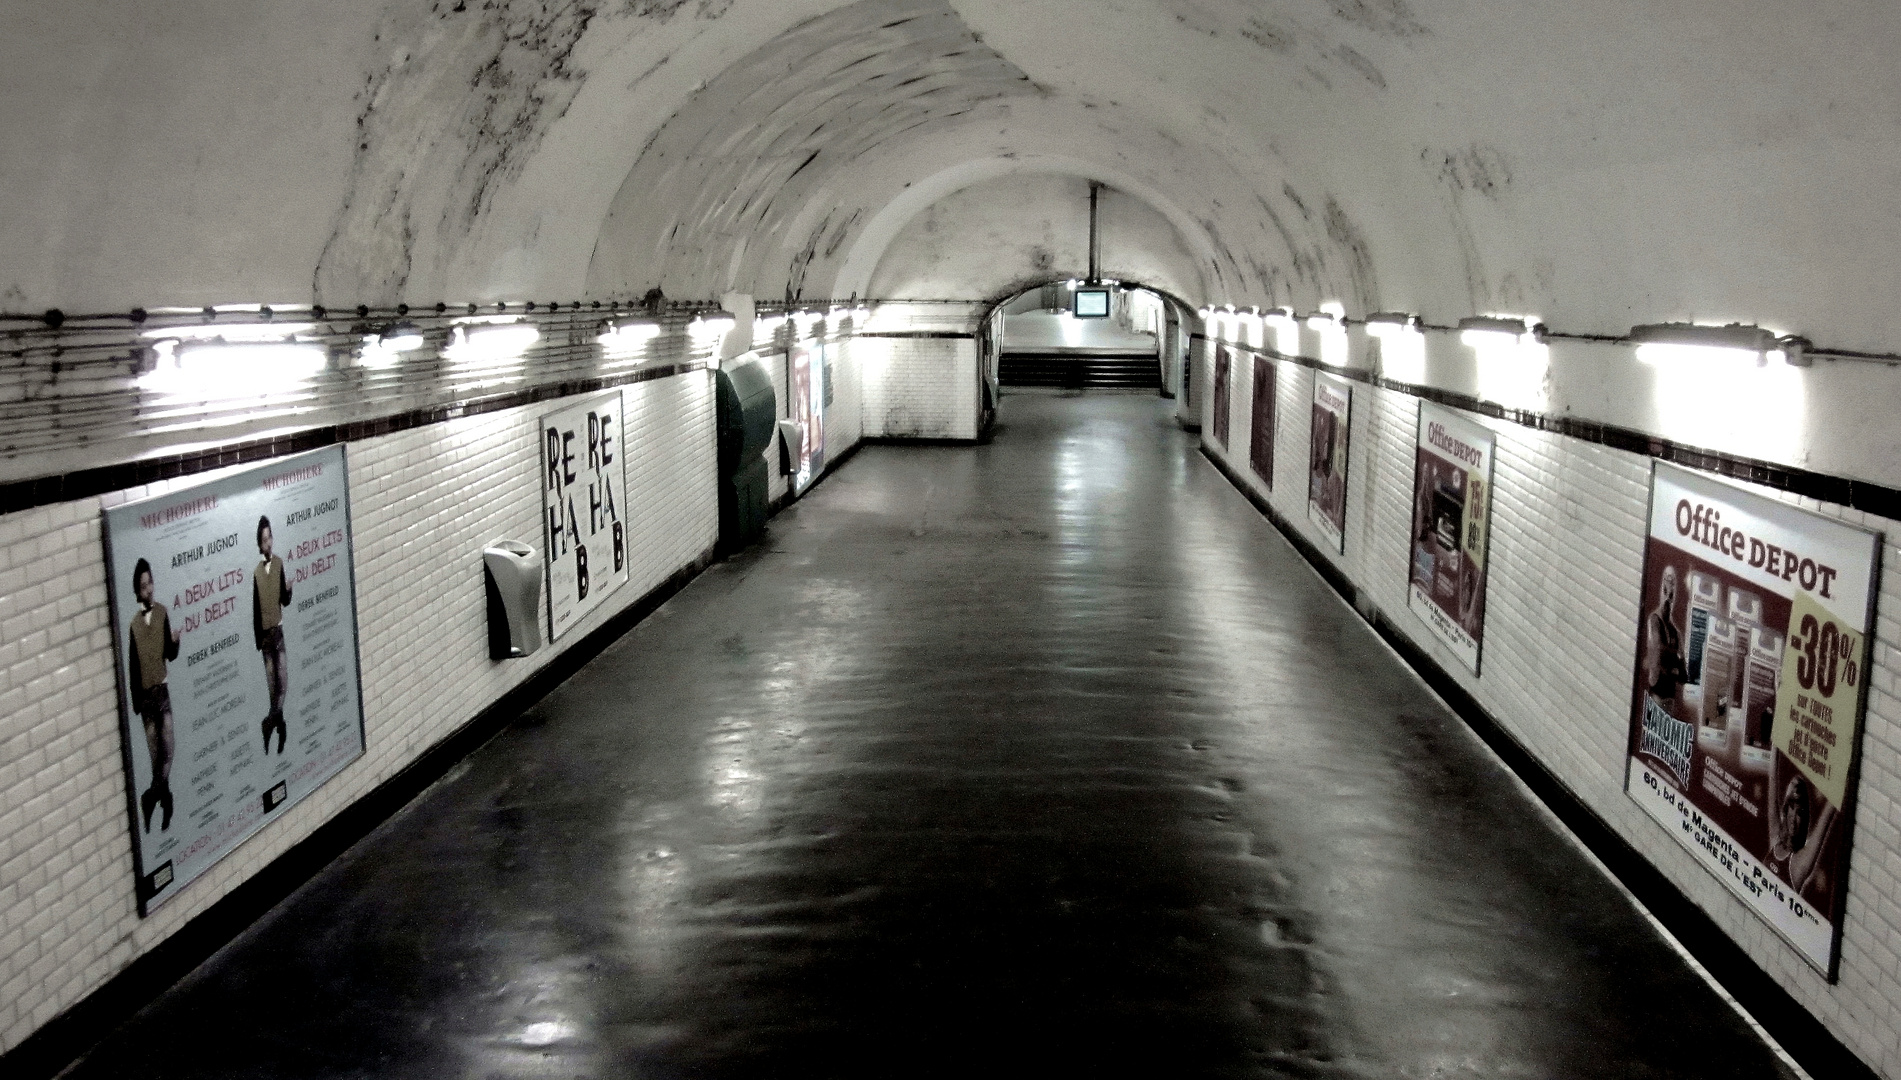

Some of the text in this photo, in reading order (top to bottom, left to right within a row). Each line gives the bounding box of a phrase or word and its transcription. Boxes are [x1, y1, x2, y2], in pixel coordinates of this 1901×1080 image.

[547, 427, 577, 499] RE
[587, 411, 613, 478] RE
[1429, 421, 1482, 468] Office DEPOT
[286, 498, 339, 526] ARTHUR JUGNOT
[549, 493, 581, 563] HA
[589, 472, 617, 537] HA
[171, 533, 239, 569] ARTHUR JUGNOT
[287, 528, 343, 562] A DEUX LITS
[296, 553, 337, 583] DU DELIT
[612, 520, 624, 574] B
[1676, 499, 1836, 599] Office DEPOT
[173, 567, 244, 610] A DEUX LITS
[575, 544, 590, 603] B
[185, 595, 236, 633] DU DELIT
[187, 633, 240, 667] DEREK BENFIELD
[1791, 613, 1857, 698] -30%
[1643, 772, 1661, 796] 60,
[1663, 786, 1675, 805] bd
[1677, 801, 1689, 817] de
[1692, 811, 1739, 863] Magenta
[1753, 866, 1785, 903] Paris
[1694, 832, 1718, 860] GARE
[1720, 853, 1733, 873] DE
[1734, 867, 1762, 898] L'EST
